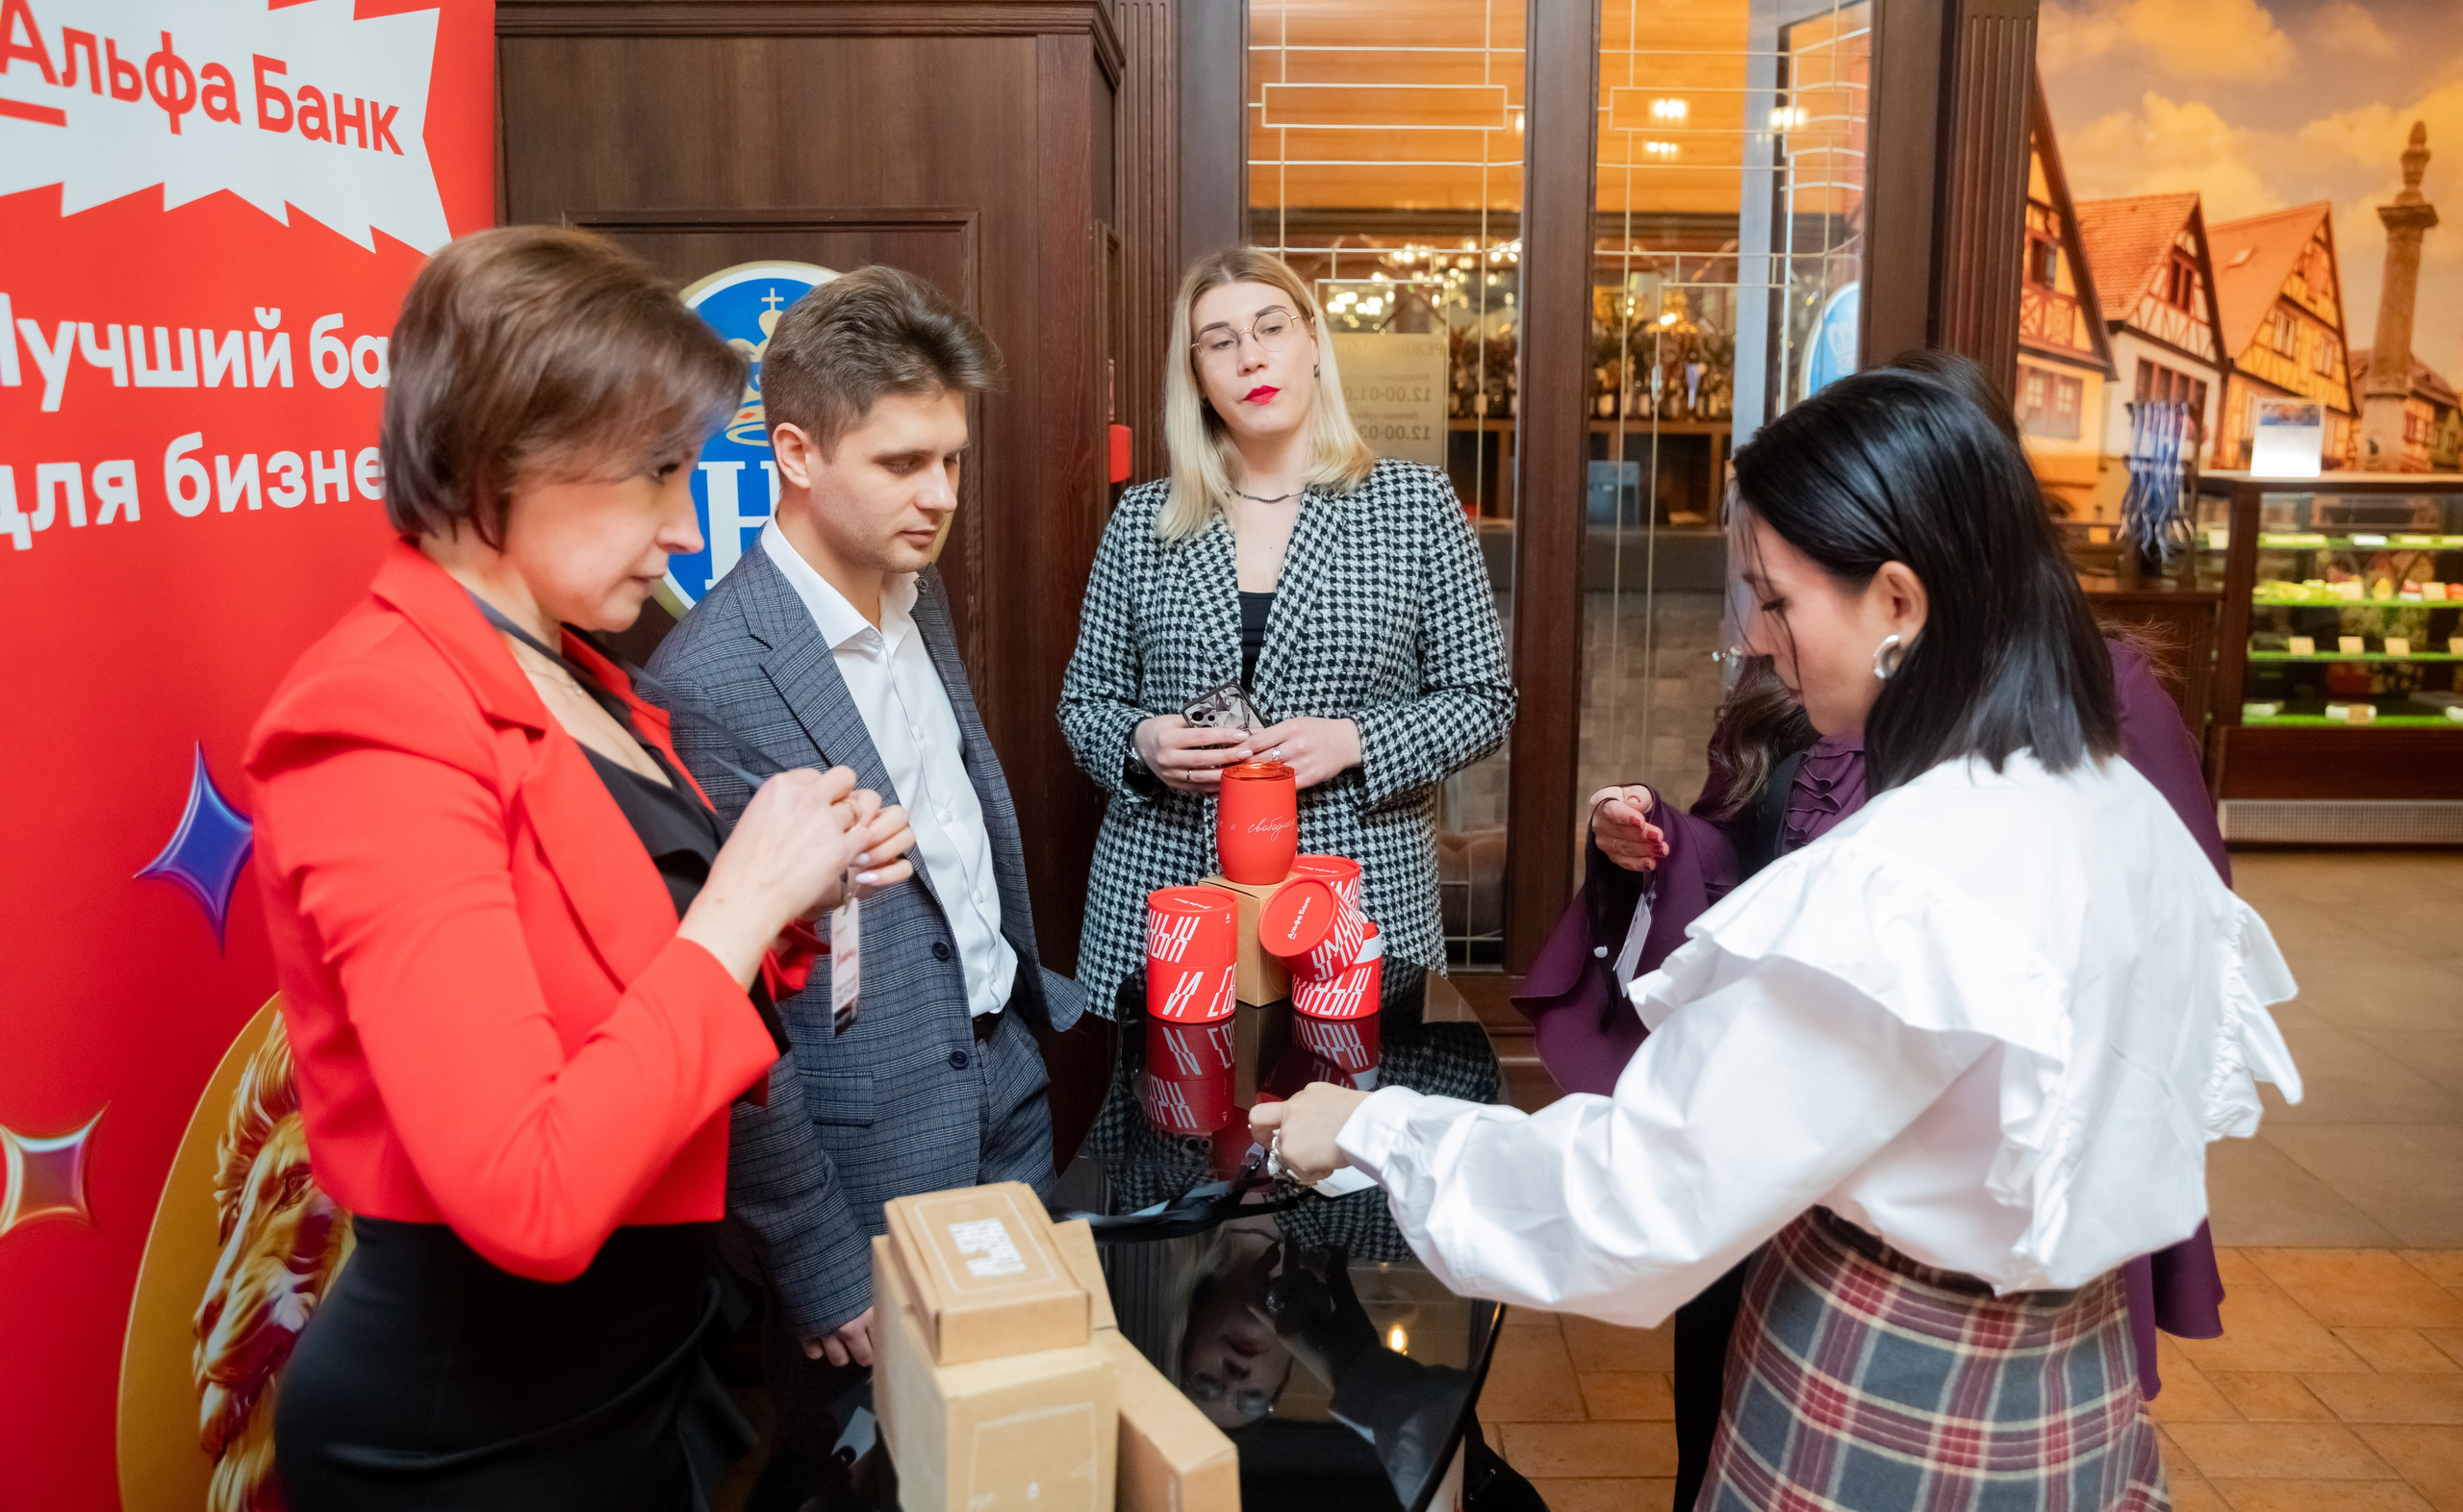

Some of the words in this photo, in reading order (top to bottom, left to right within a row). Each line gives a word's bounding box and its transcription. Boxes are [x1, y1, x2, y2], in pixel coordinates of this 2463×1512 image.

[0, 0, 241, 136] Альфа
[252, 53, 405, 156] Банк
[309, 313, 390, 389] ба
[164, 431, 387, 518] бизне
[1298, 896, 1312, 915] Банк
